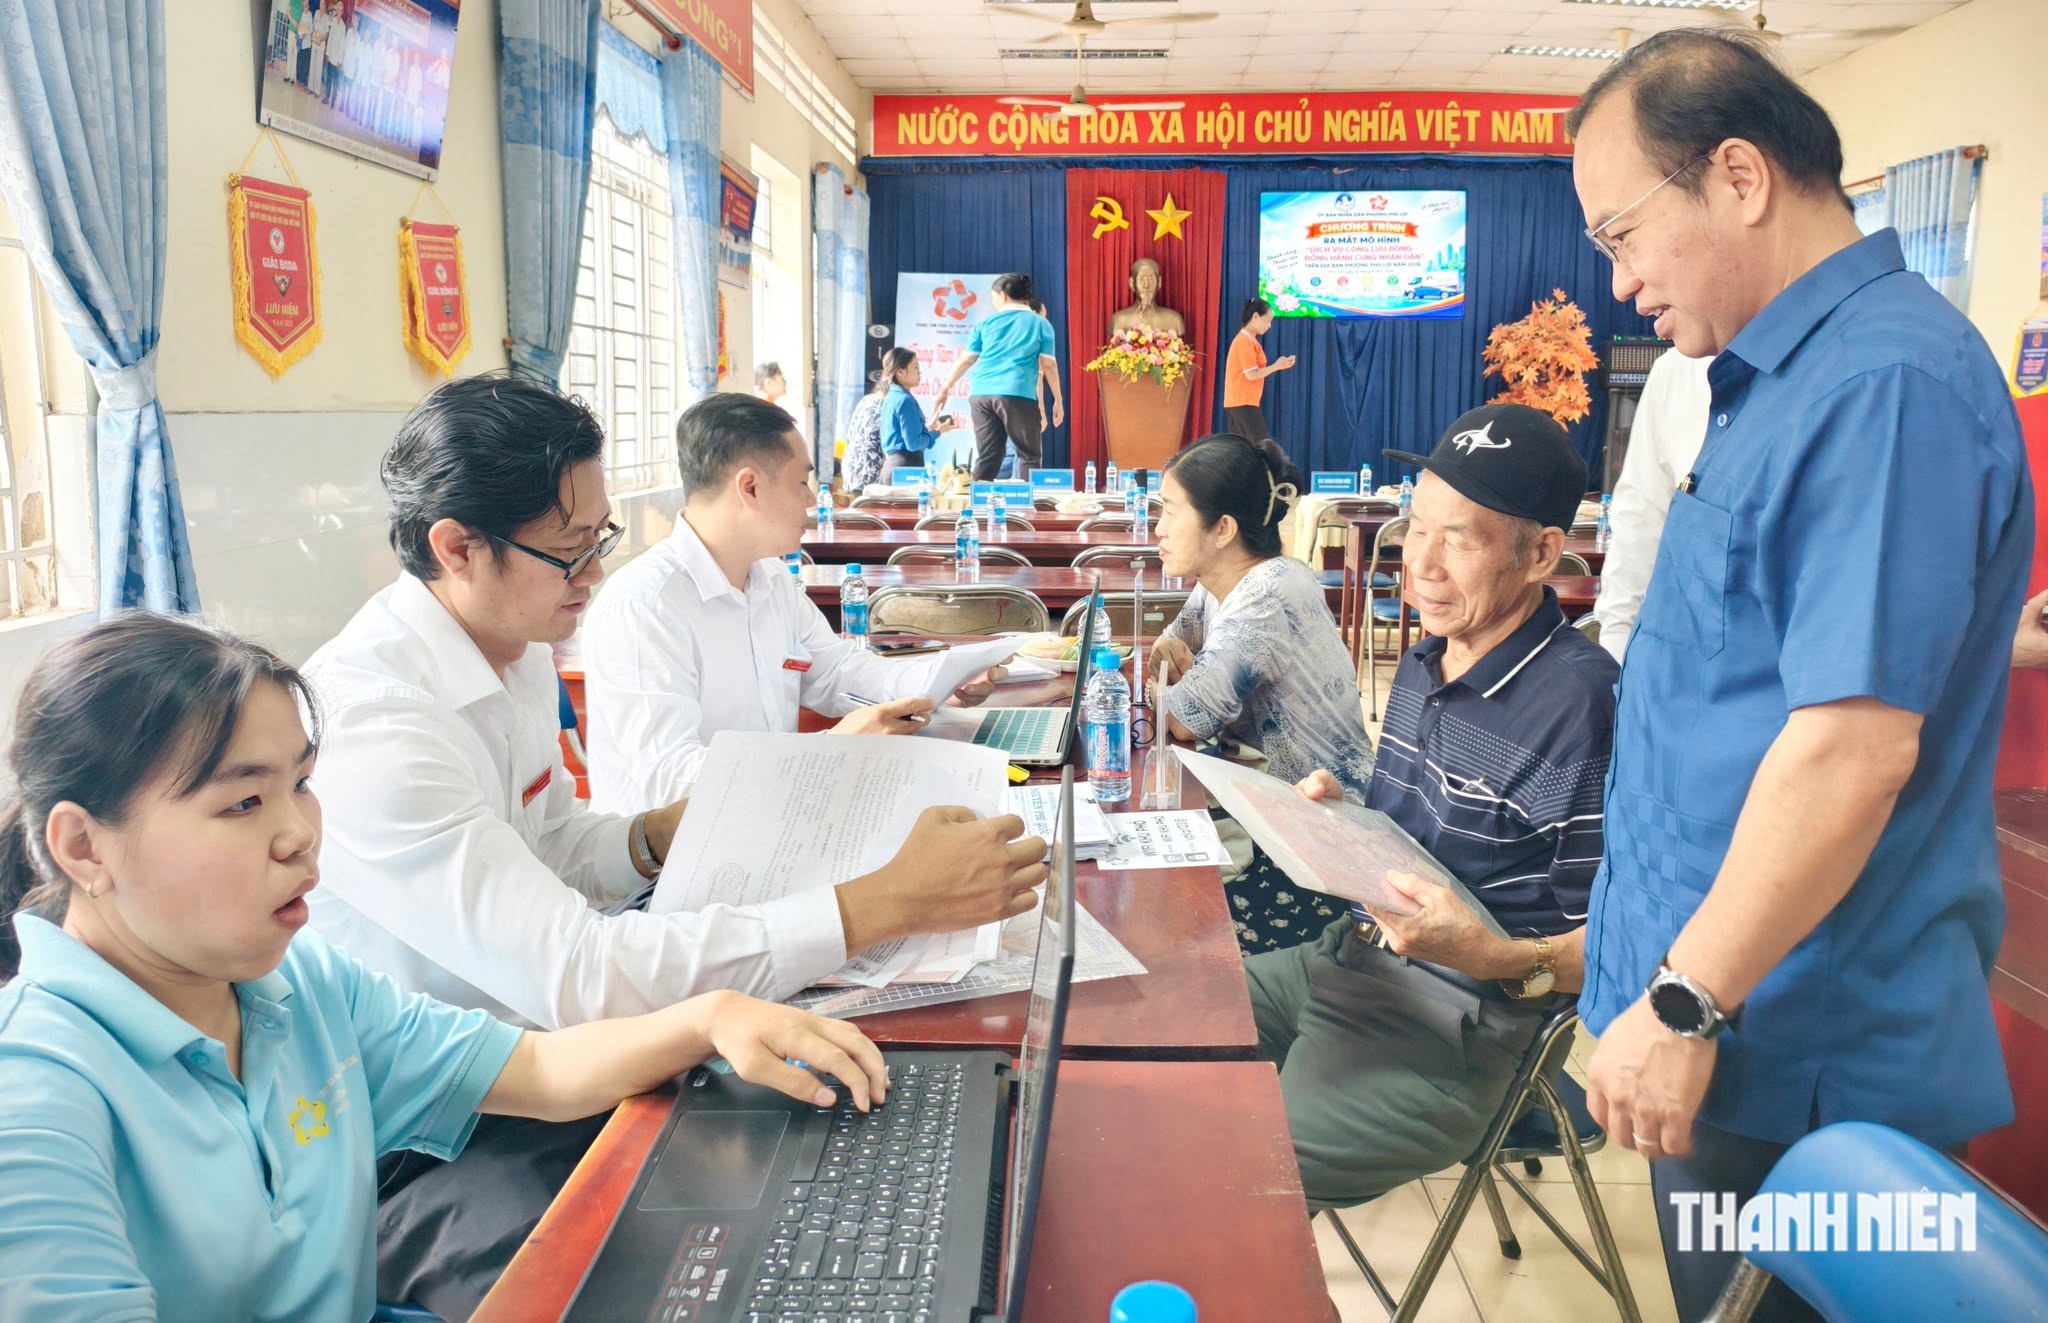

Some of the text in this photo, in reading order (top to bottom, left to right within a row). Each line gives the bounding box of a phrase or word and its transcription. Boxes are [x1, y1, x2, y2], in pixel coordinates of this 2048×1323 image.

[897, 104, 978, 145] NƯỚC
[988, 103, 1070, 151] CỘNG
[1196, 102, 1244, 150] HỘI
[1254, 98, 1311, 143] CHỦ
[1323, 100, 1407, 143] NGHĨA
[1415, 100, 1481, 149] VIỆT
[1491, 110, 1553, 144] NAM
[1319, 222, 1406, 234] CHƯƠNG TRÌNH
[1338, 235, 1357, 244] MẮT
[1360, 236, 1375, 244] MÔ
[1377, 235, 1400, 244] HÌNH
[1098, 727, 1107, 769] BIWASE
